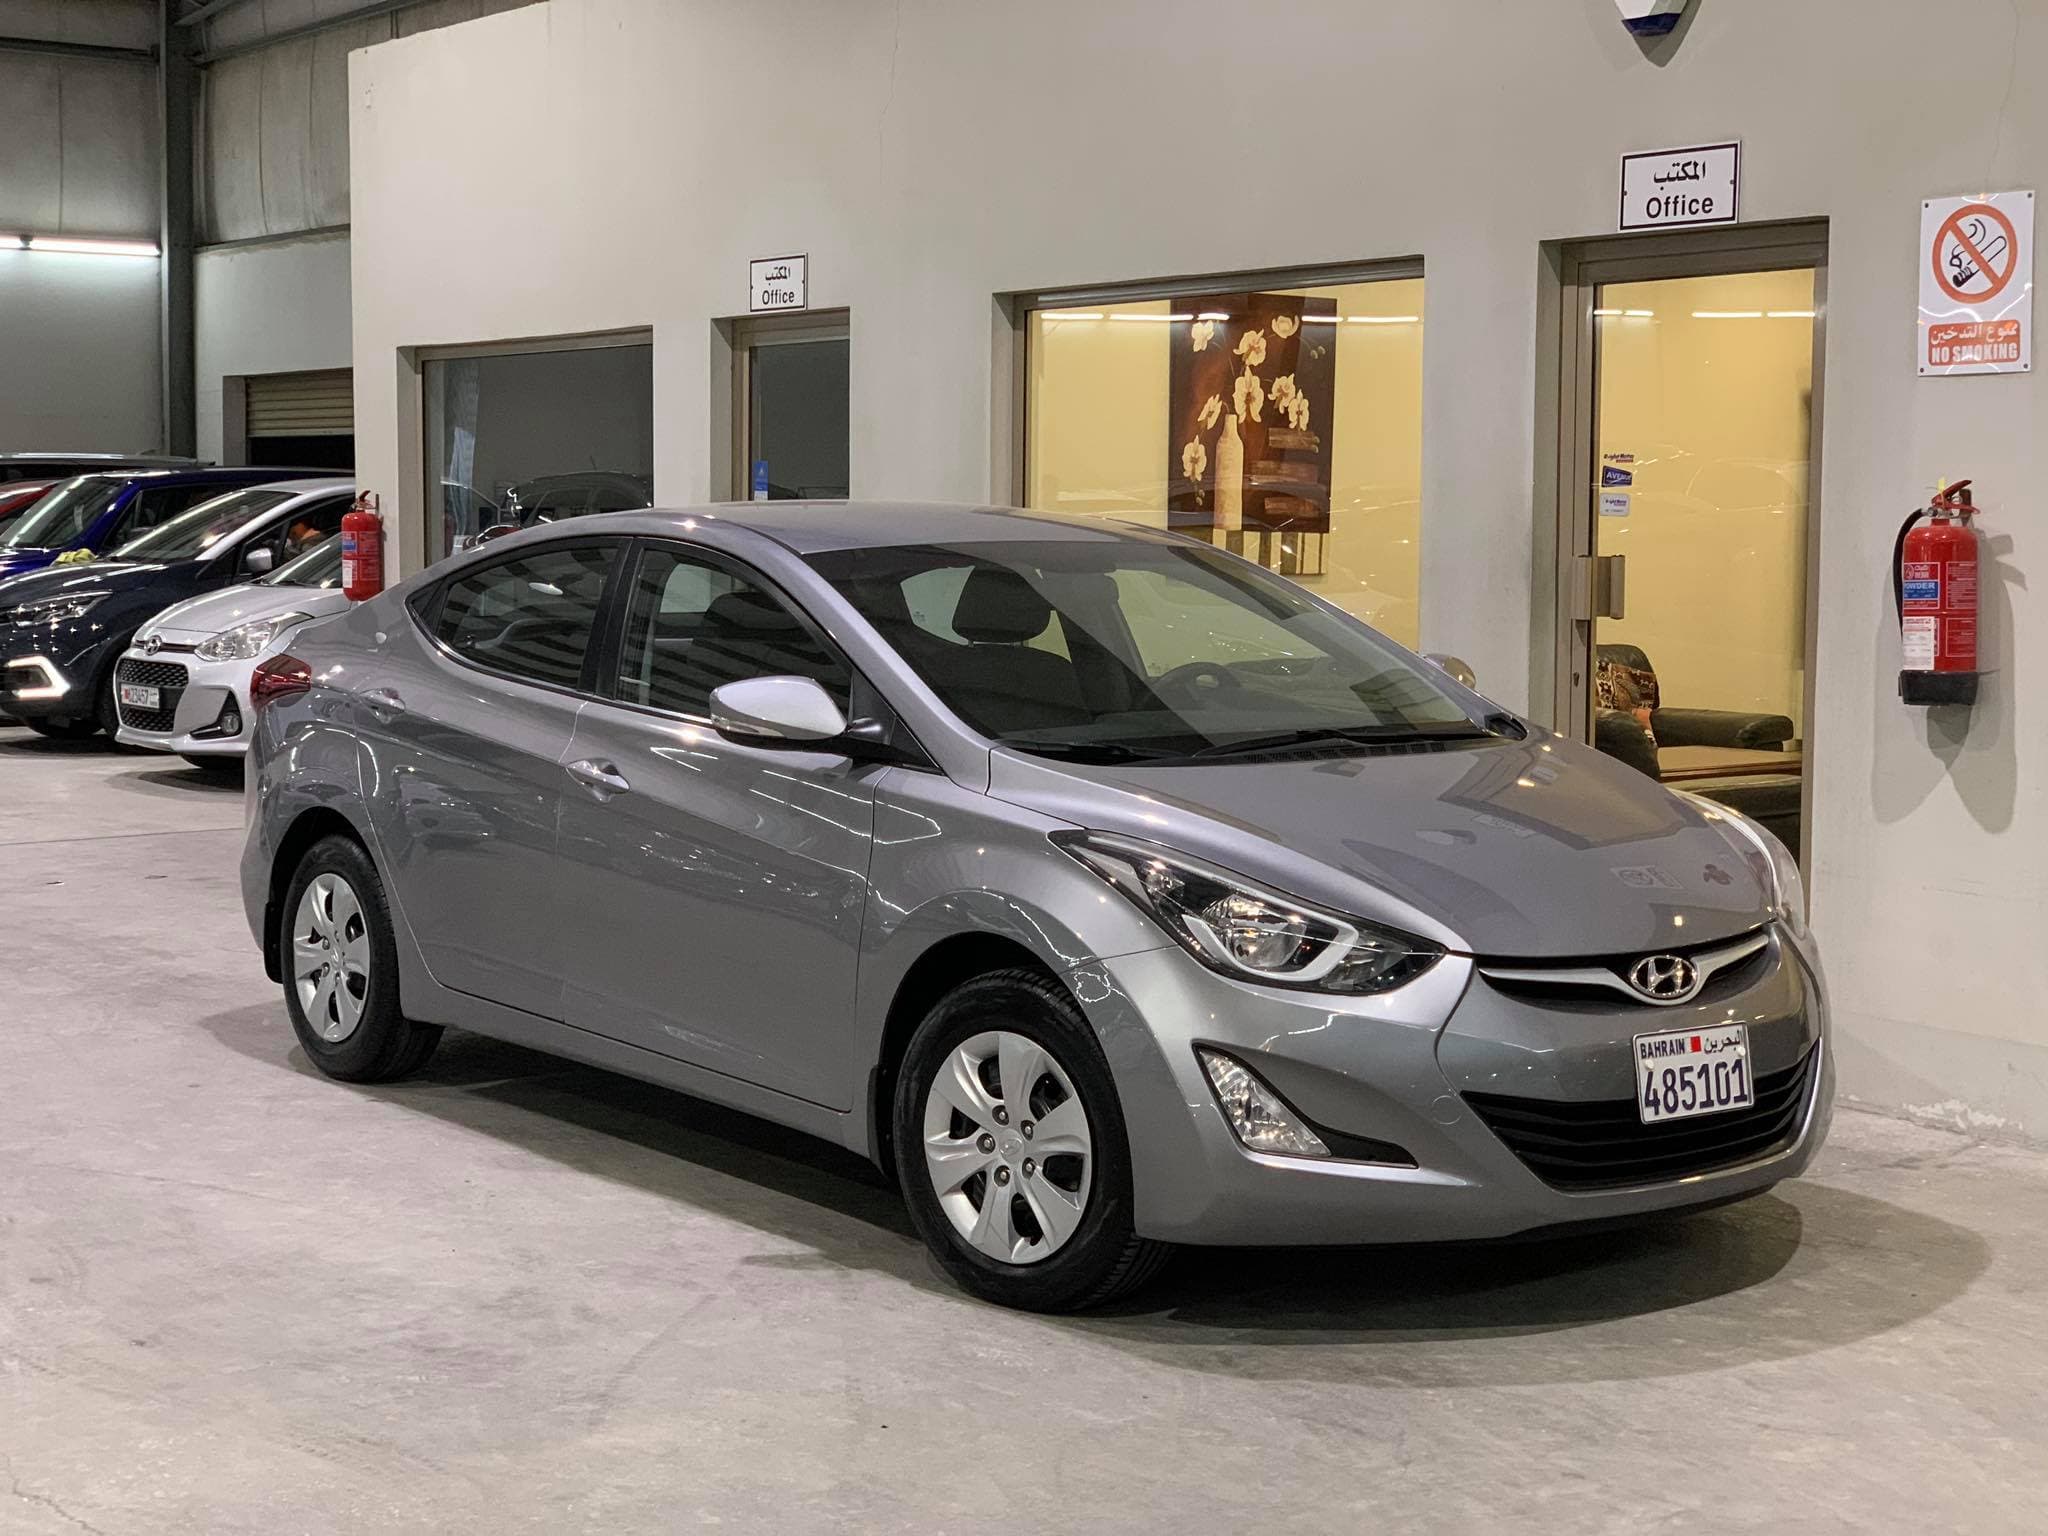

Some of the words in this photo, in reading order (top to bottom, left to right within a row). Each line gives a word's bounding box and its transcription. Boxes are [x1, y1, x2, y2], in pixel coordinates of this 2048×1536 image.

[1654, 160, 1706, 190] المكتب
[1646, 195, 1714, 219] Office
[765, 266, 791, 286] المكتب
[762, 289, 795, 305] Office
[1931, 346, 1950, 364] NO
[1952, 342, 2018, 362] SMOKING
[1640, 1039, 1685, 1059] BAHRAIN
[1645, 1058, 1748, 1116] 485101
